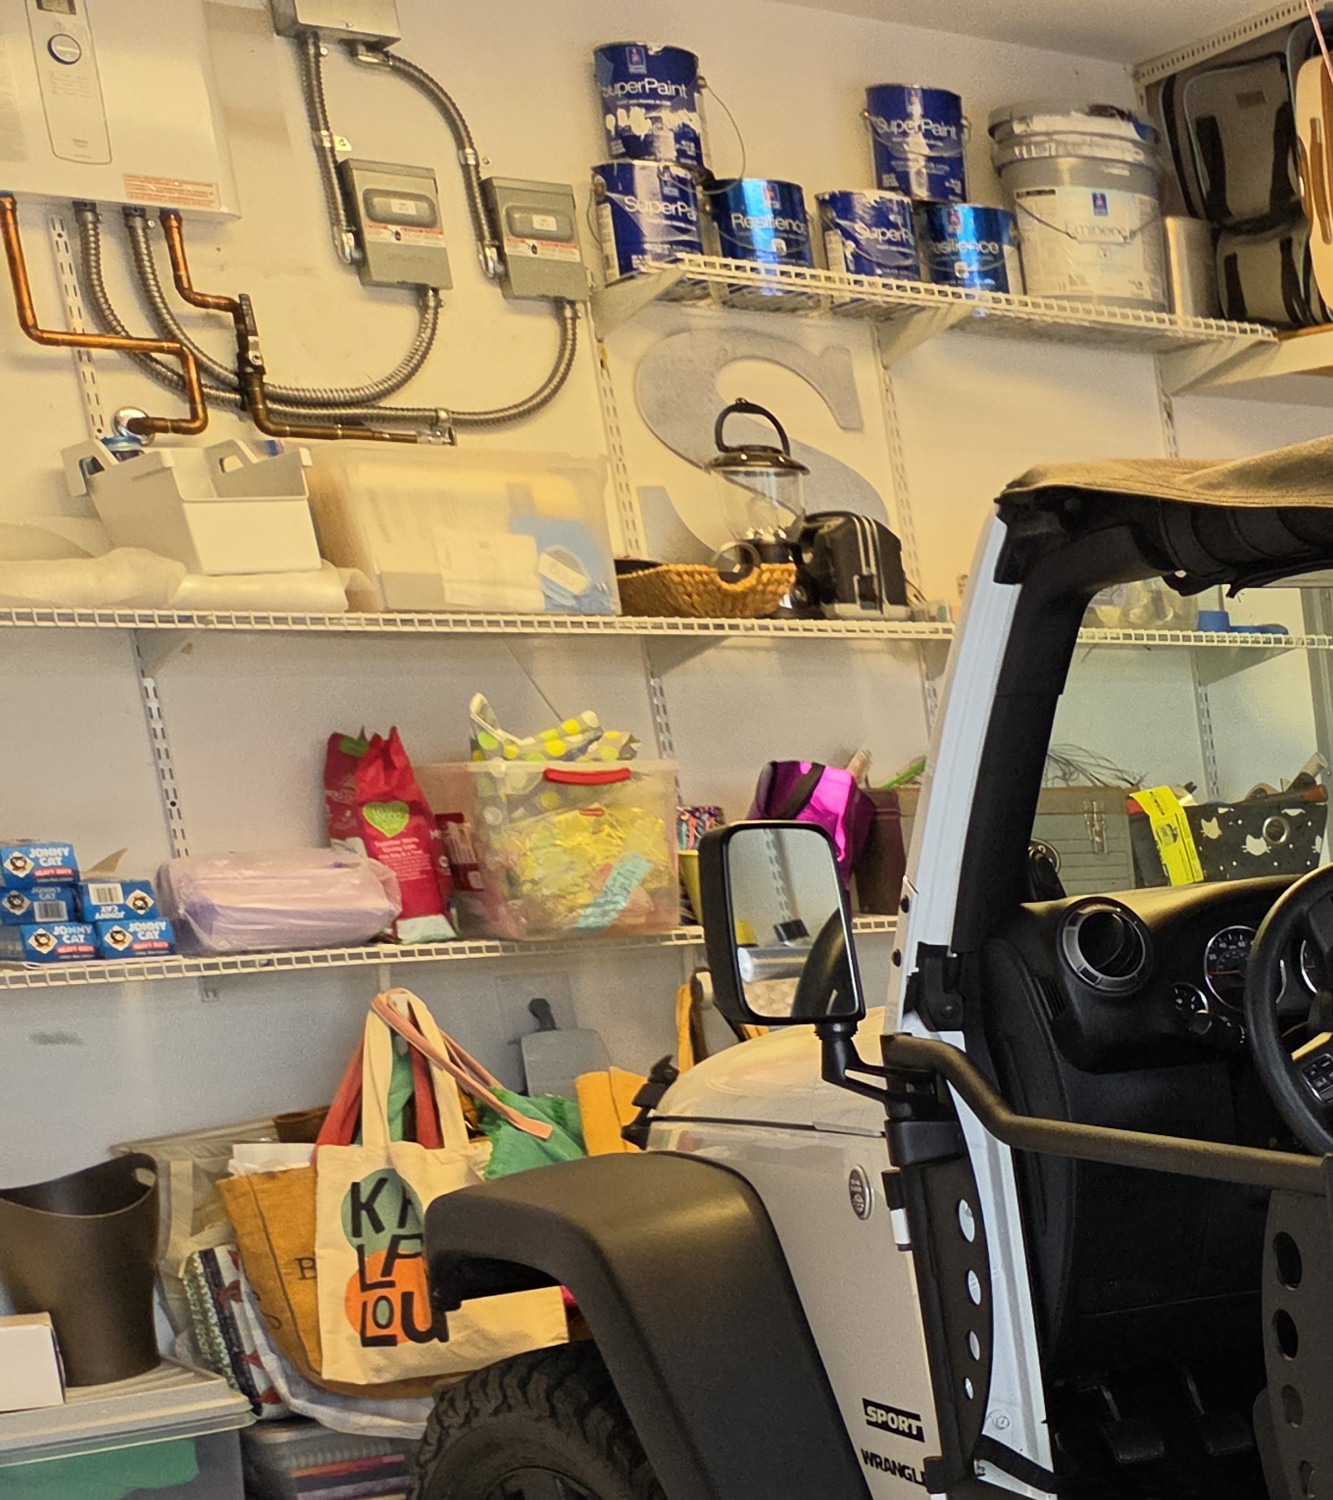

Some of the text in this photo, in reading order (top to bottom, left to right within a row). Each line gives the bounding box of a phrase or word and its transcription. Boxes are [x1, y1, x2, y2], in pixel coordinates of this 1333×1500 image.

[29, 847, 69, 858] JONNY
[39, 857, 63, 867] CAT
[53, 925, 93, 936] JONNY
[128, 921, 166, 932] JONNY
[62, 934, 85, 944] CAT
[137, 930, 160, 941] CAT
[360, 1290, 450, 1348] LOU
[865, 1404, 923, 1436] SPORT
